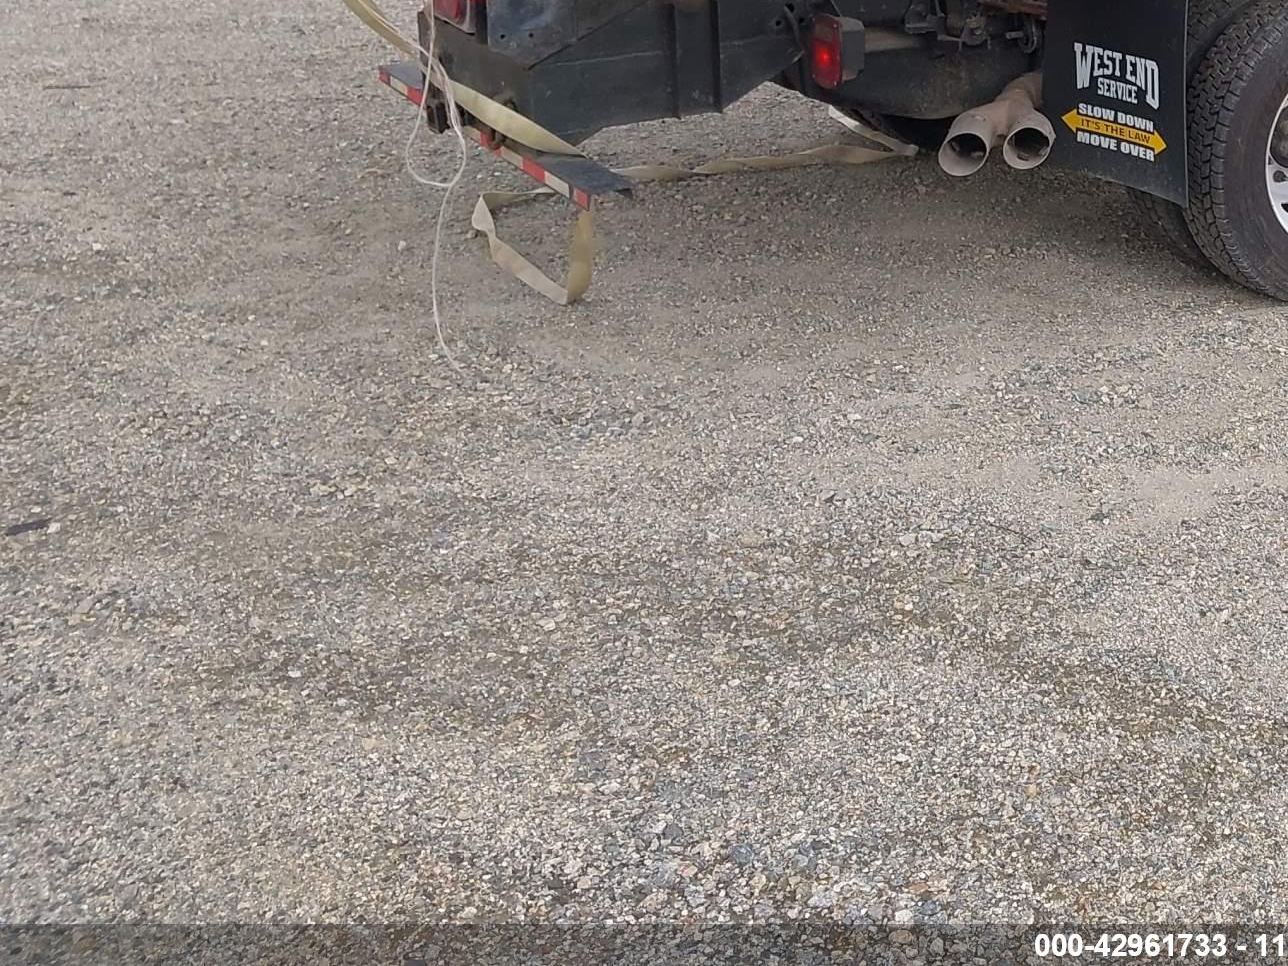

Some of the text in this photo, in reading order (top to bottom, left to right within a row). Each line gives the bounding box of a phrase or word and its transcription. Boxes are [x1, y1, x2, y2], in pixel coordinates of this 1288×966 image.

[1074, 42, 1160, 110] WEST END
[1097, 78, 1138, 104] SERVICE
[1078, 102, 1154, 132] SLOW DOWN
[1081, 118, 1151, 144] IT'S THE LAW
[1076, 131, 1155, 162] MOVE OVER
